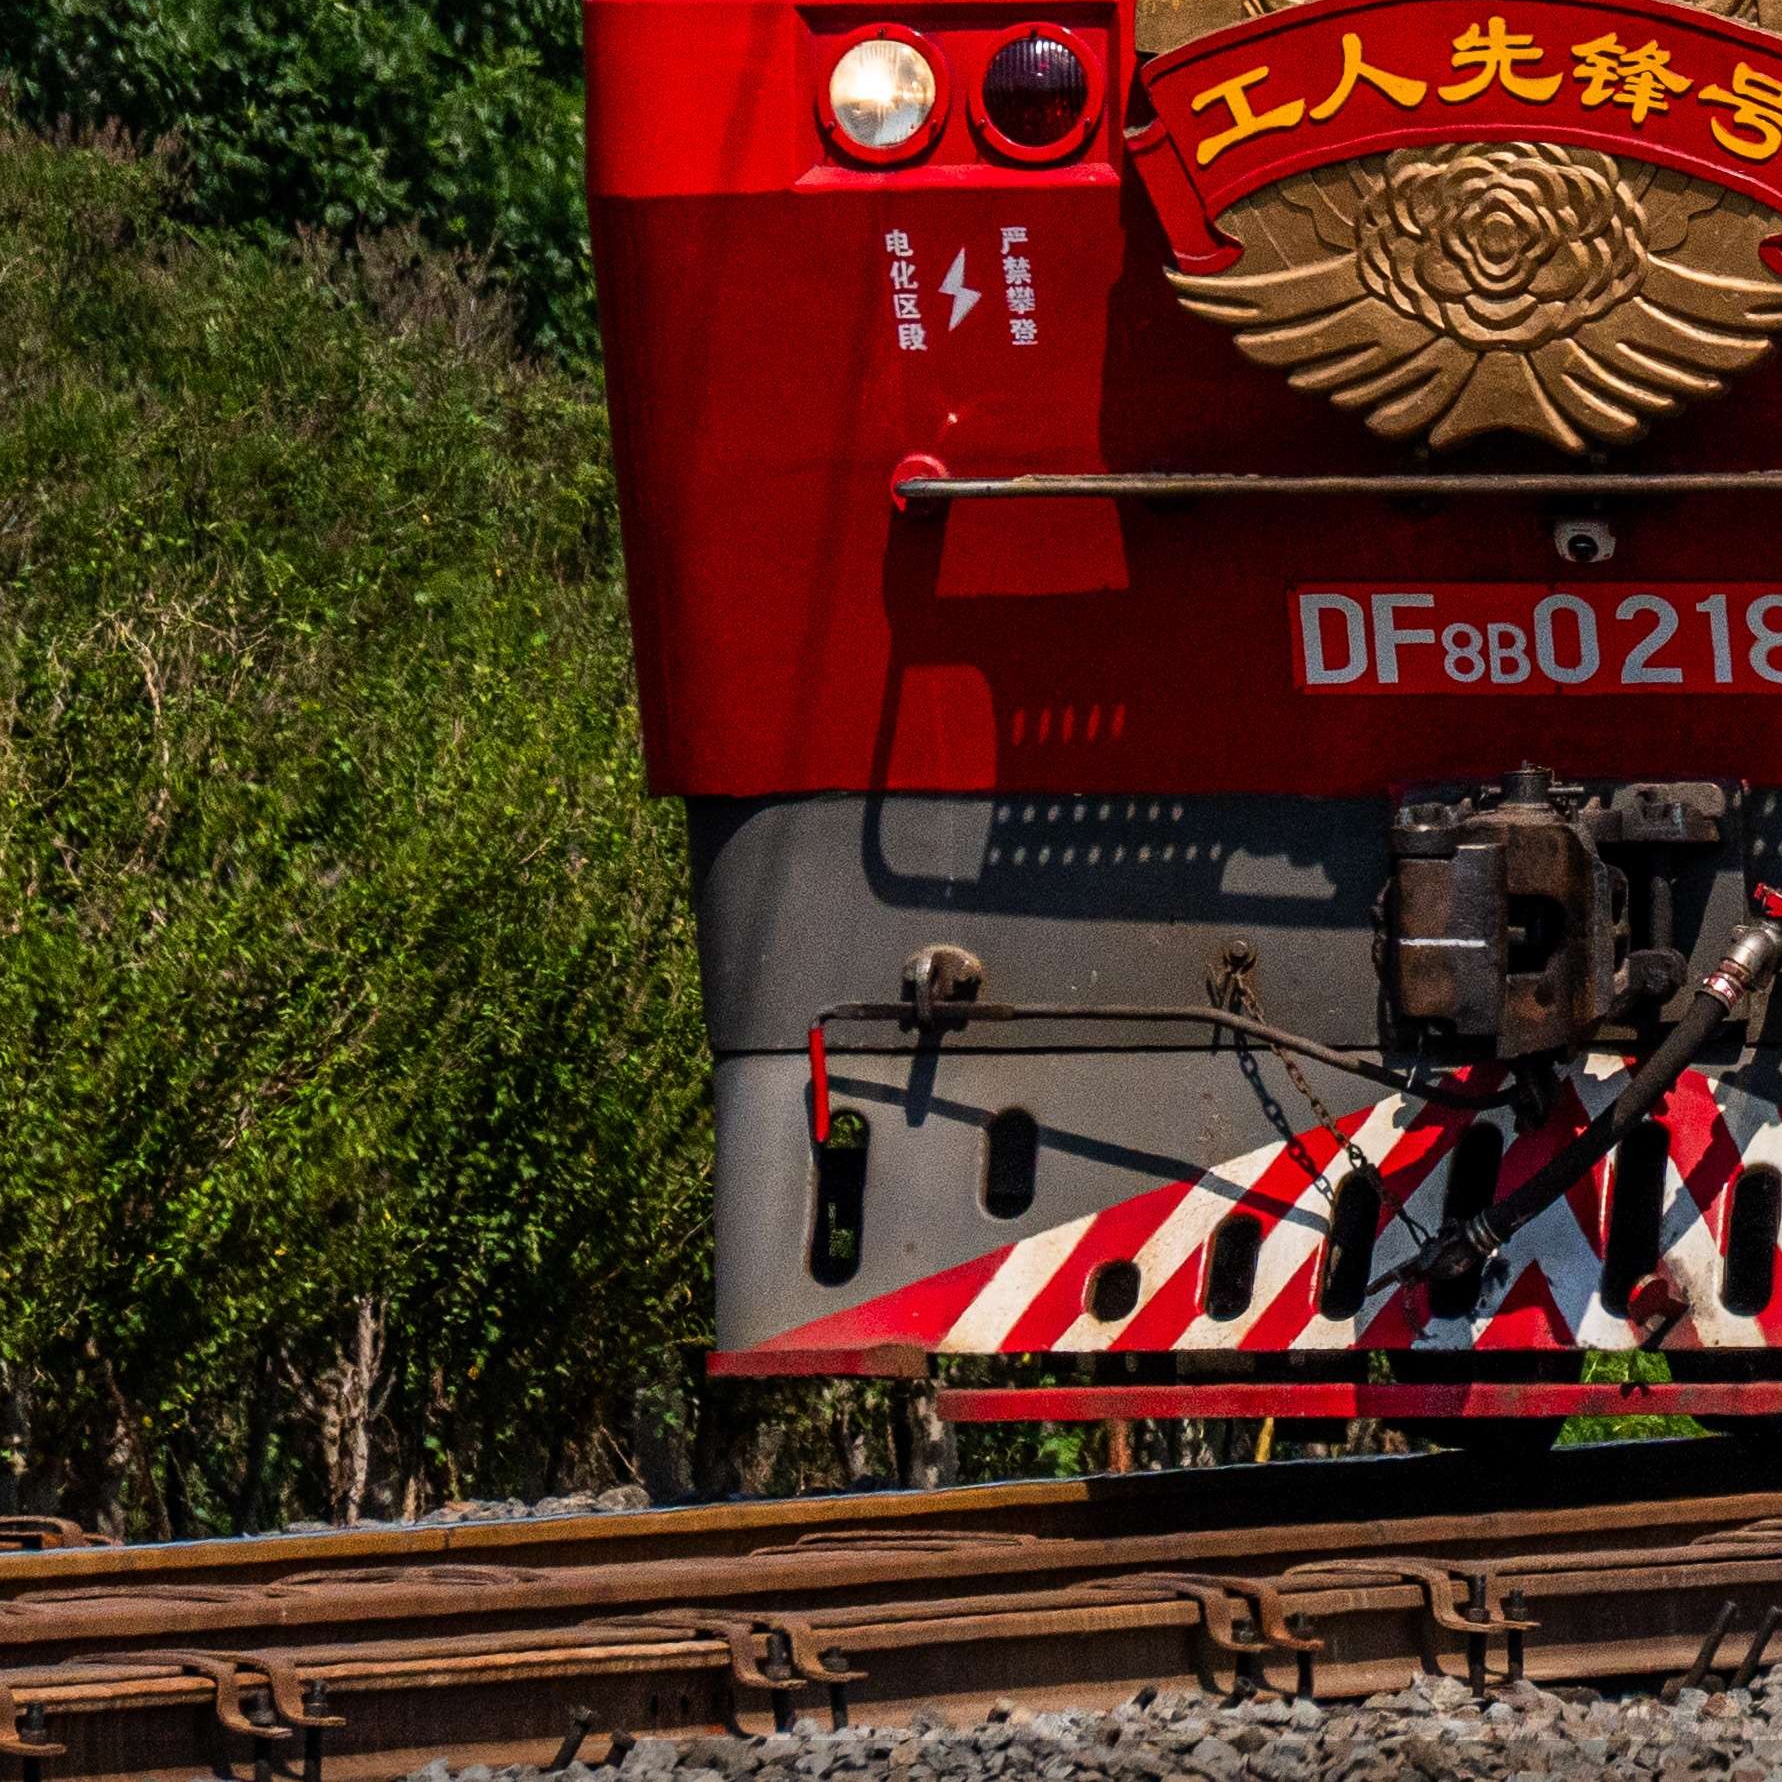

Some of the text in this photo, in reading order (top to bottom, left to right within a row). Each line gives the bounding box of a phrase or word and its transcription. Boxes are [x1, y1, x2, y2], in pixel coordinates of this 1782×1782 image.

[885, 228, 928, 351] 电化区段
[1000, 225, 1039, 346] 严禁攀登
